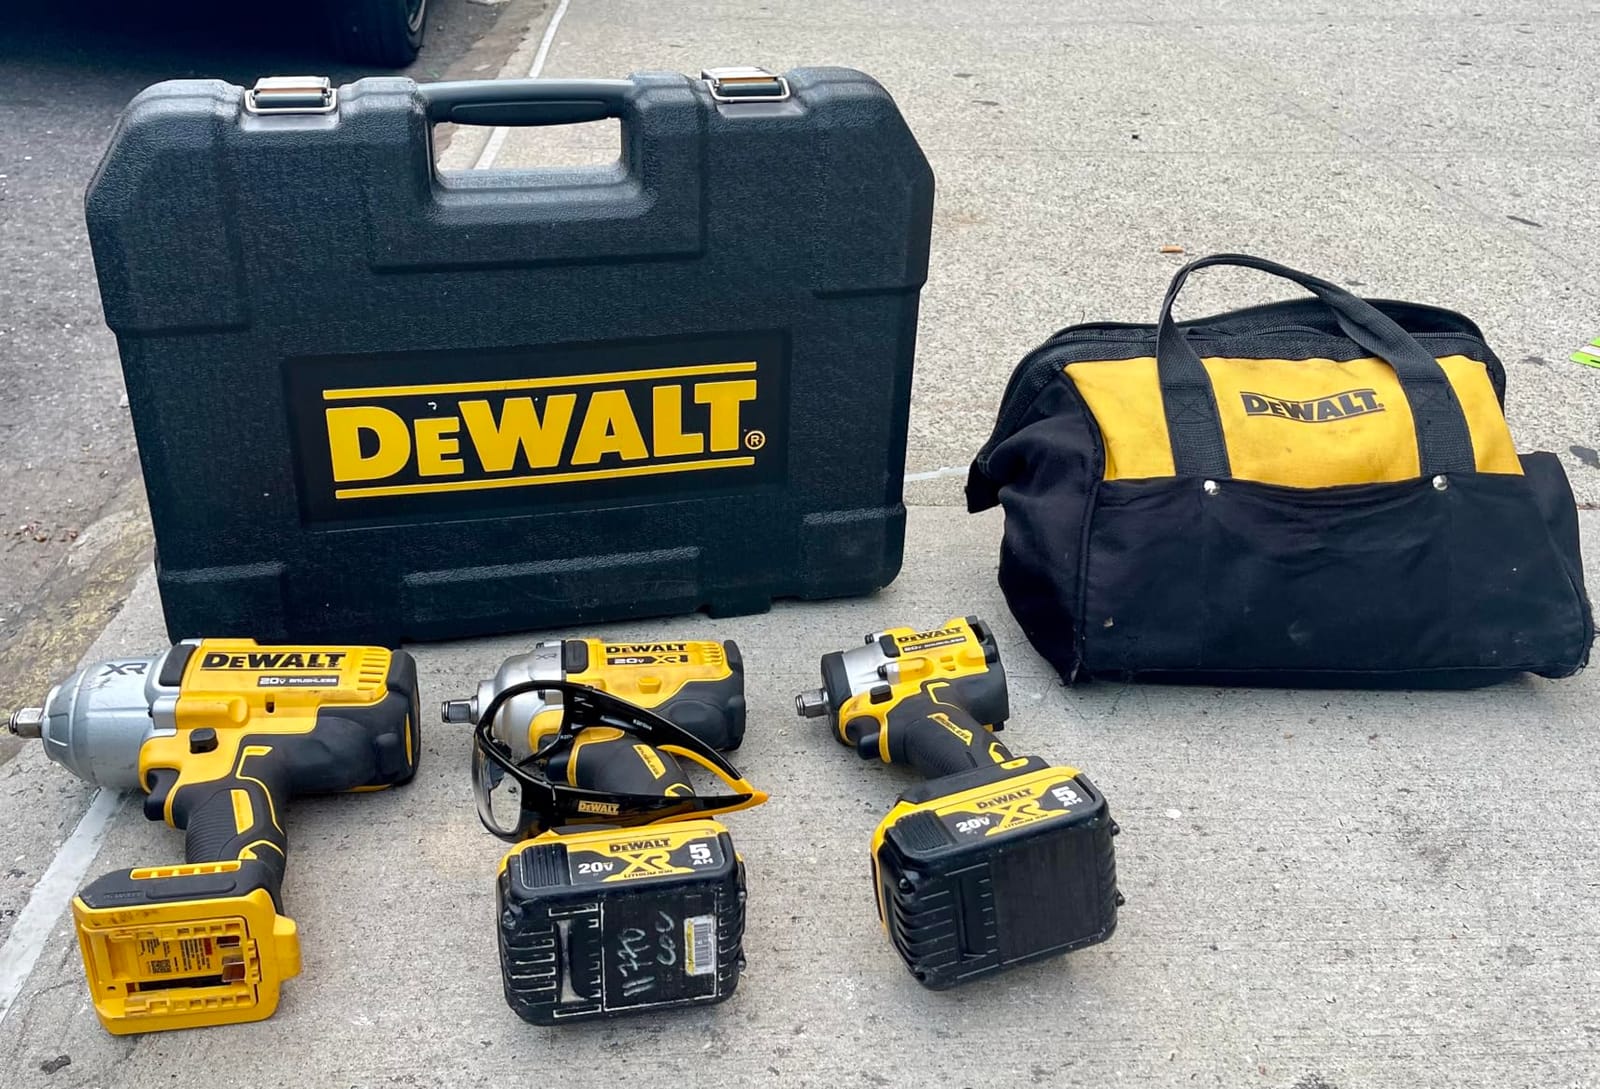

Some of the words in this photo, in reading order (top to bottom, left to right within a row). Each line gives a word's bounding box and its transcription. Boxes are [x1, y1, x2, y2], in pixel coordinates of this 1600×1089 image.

[100, 662, 148, 676] XR
[1051, 786, 1078, 801] 5
[688, 843, 711, 860] 5
[616, 850, 677, 874] XR
